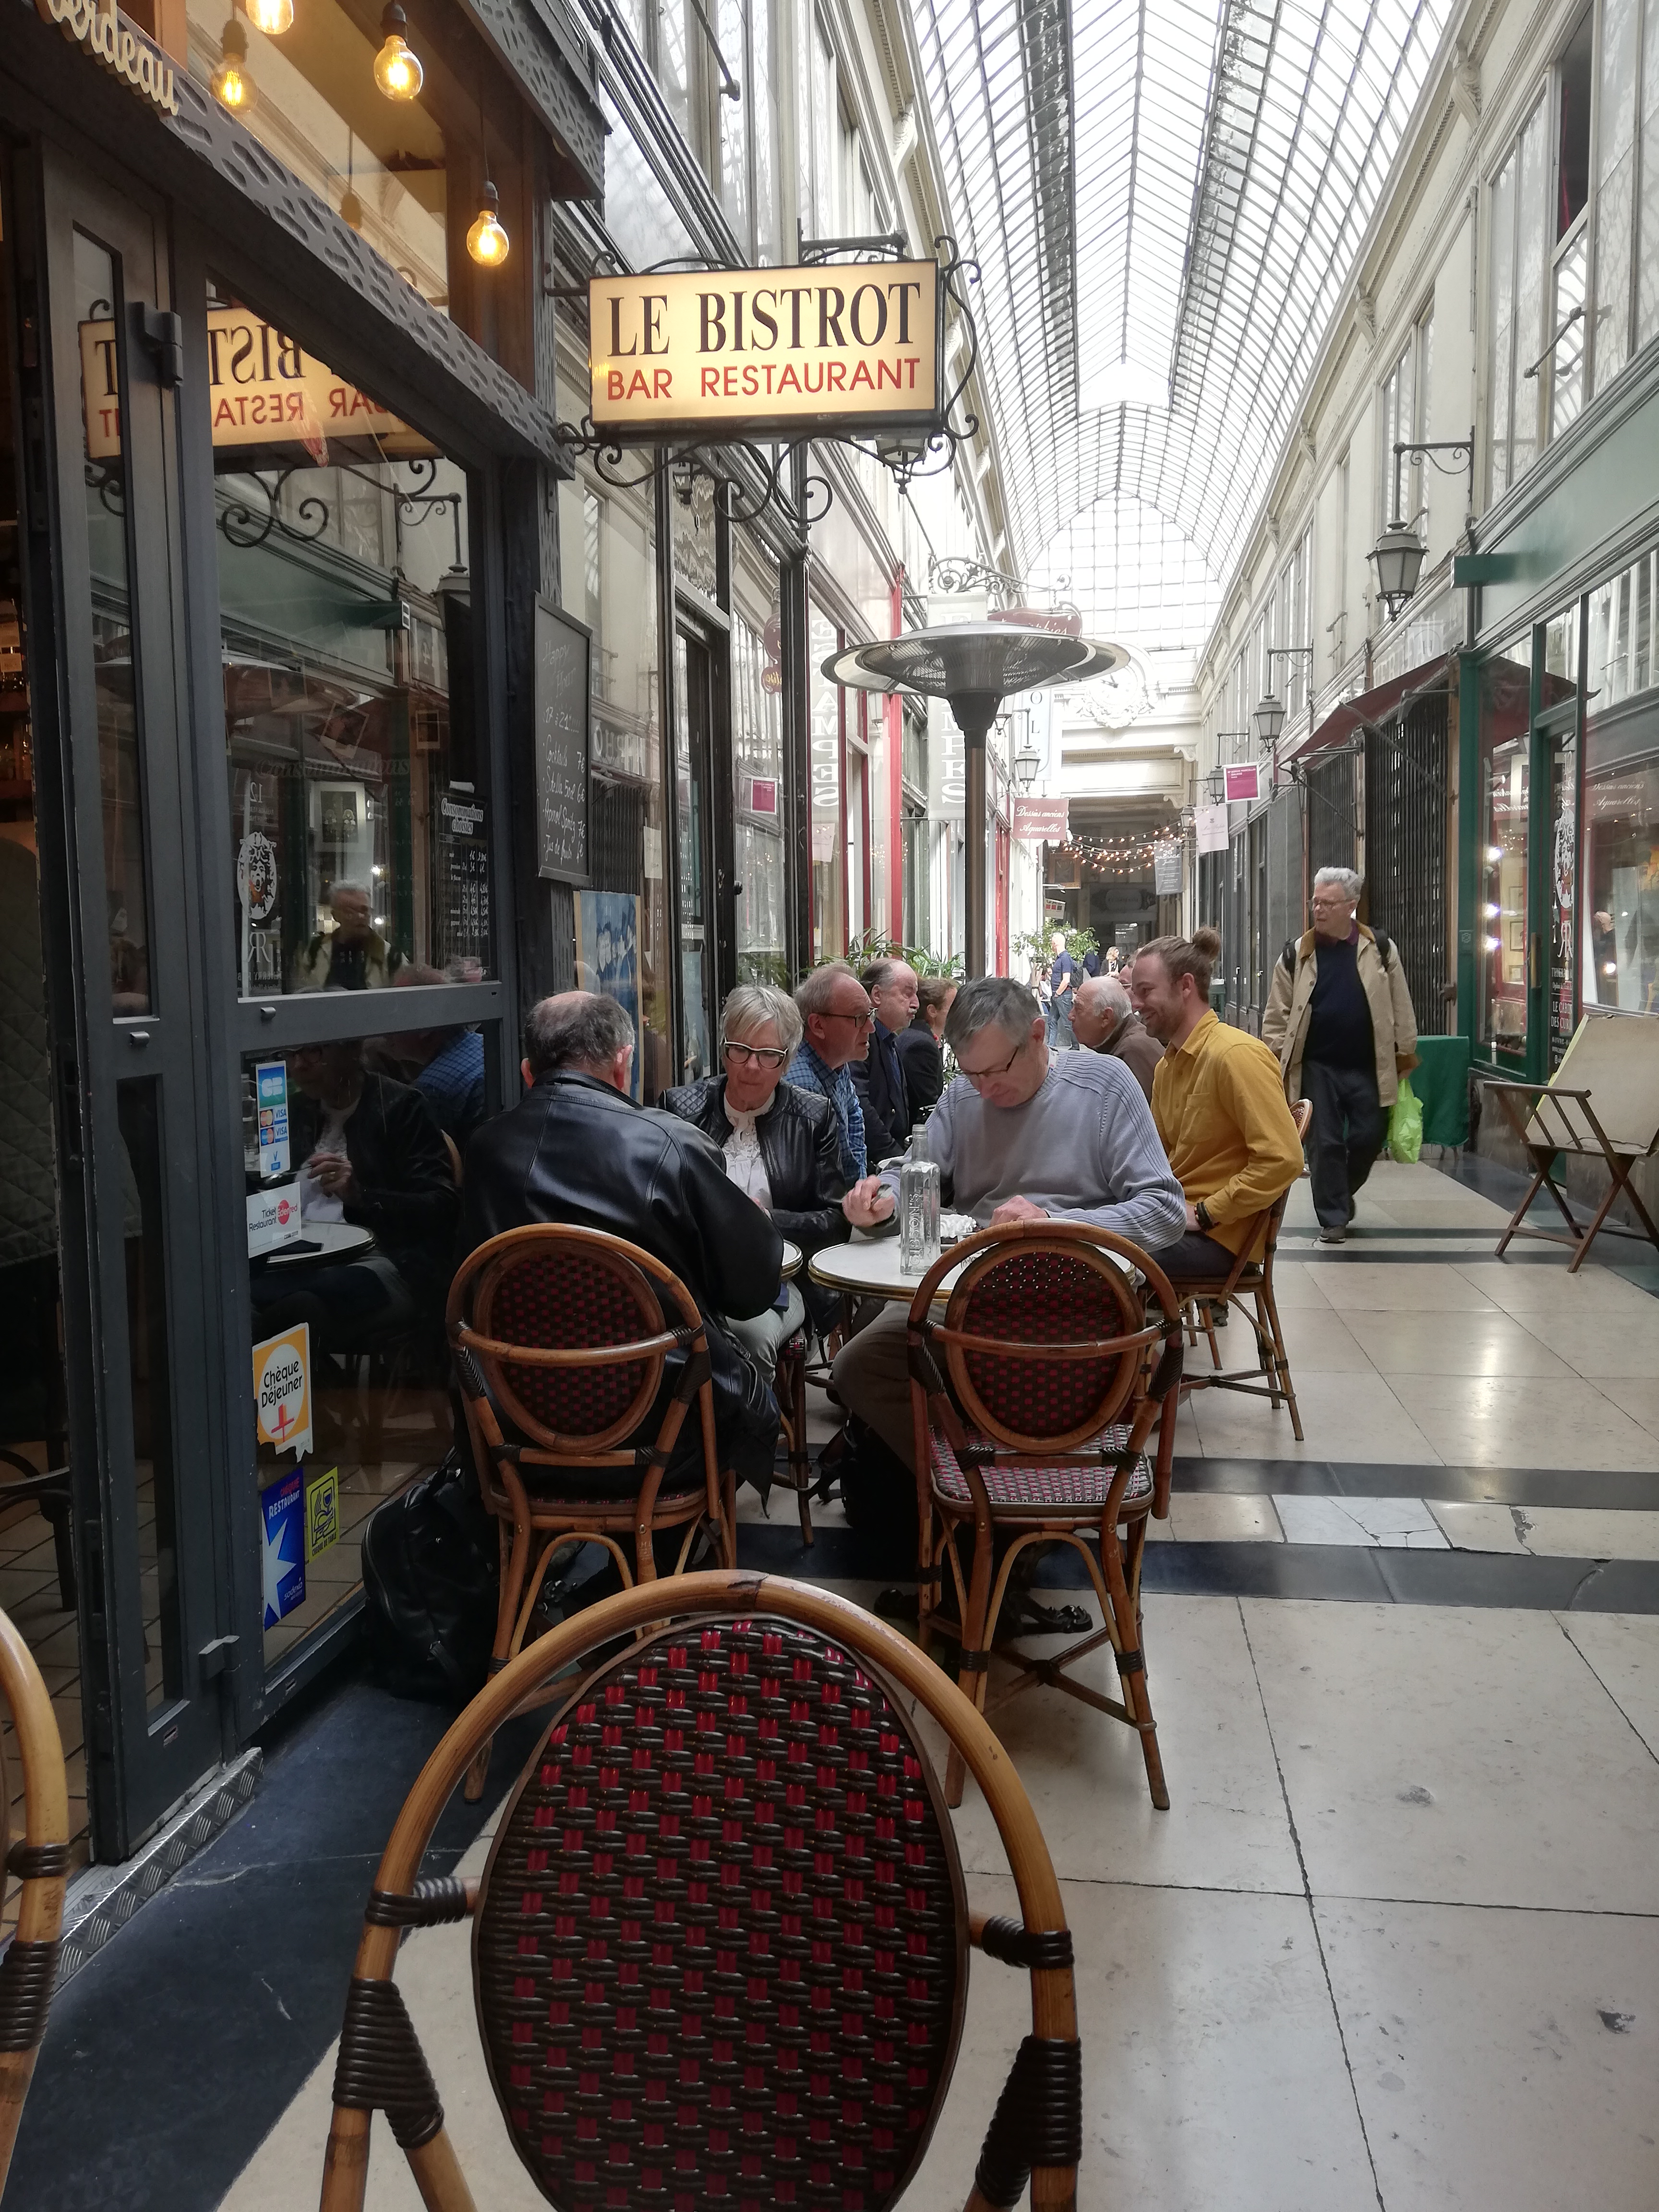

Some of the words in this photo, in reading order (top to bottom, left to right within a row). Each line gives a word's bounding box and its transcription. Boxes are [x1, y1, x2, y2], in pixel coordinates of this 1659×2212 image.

[607, 295, 670, 357] LE
[695, 282, 921, 353] BISTROT
[608, 368, 673, 401] BAR
[701, 358, 921, 397] RESTAURANT
[577, 751, 585, 773] 7€
[545, 765, 563, 793] Stella
[577, 782, 585, 803] 6€
[441, 797, 484, 822] Consommations
[1015, 805, 1041, 817] Dessins
[1041, 809, 1065, 817] anciens
[577, 820, 586, 839] 7€
[1019, 821, 1061, 836] Aquarelles
[545, 834, 553, 862] Jus
[554, 837, 560, 855] de
[276, 1108, 287, 1118] VISA
[276, 1126, 288, 1136] VISA
[262, 1206, 276, 1218] Ticket
[277, 1203, 298, 1217] Edenred
[249, 1217, 277, 1232] Restaurant
[264, 1360, 299, 1388] Chèque
[262, 1375, 302, 1408] Déjeuner
[269, 1490, 300, 1520] RESTAURANT
